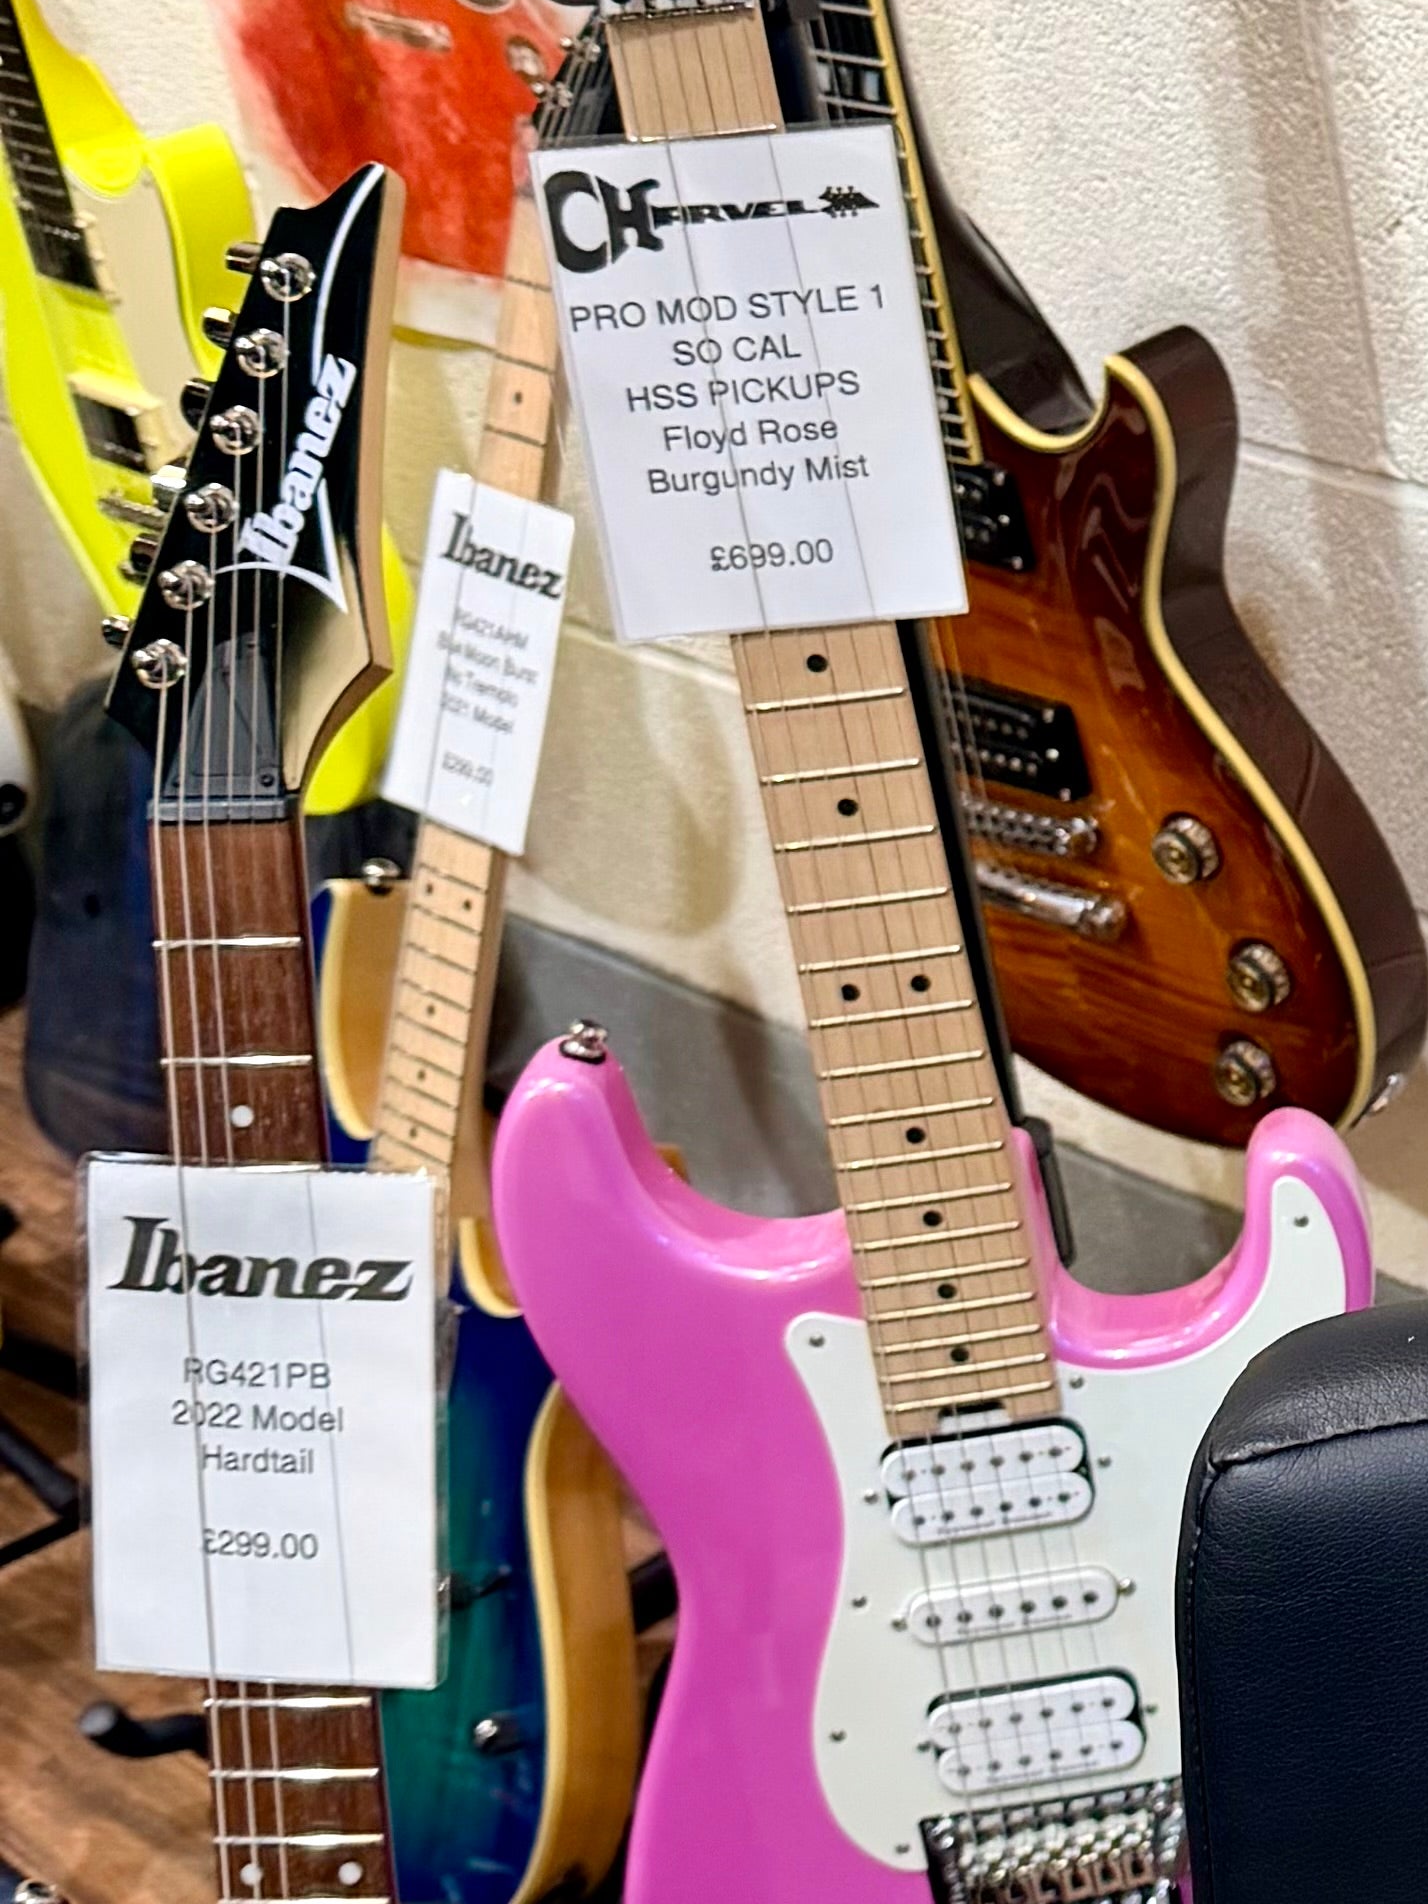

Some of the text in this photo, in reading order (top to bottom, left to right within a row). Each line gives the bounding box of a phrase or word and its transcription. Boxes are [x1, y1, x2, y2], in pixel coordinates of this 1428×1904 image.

[569, 284, 885, 333] PRO MOD STYLE 1
[672, 333, 803, 367] SO CAL
[626, 370, 862, 413] HSS PICKUPS
[663, 418, 839, 456] Floyd Rose
[234, 353, 357, 566] Ibanez
[647, 454, 871, 498] Burgundy Mist
[440, 511, 565, 600] Ibanez
[709, 536, 835, 573] £699.00
[106, 1215, 414, 1304] Ibanez
[182, 1356, 332, 1389] RG421PB
[171, 1399, 344, 1433] 2022 Model
[202, 1443, 315, 1475] Hardtail
[202, 1528, 319, 1560] £299.00
